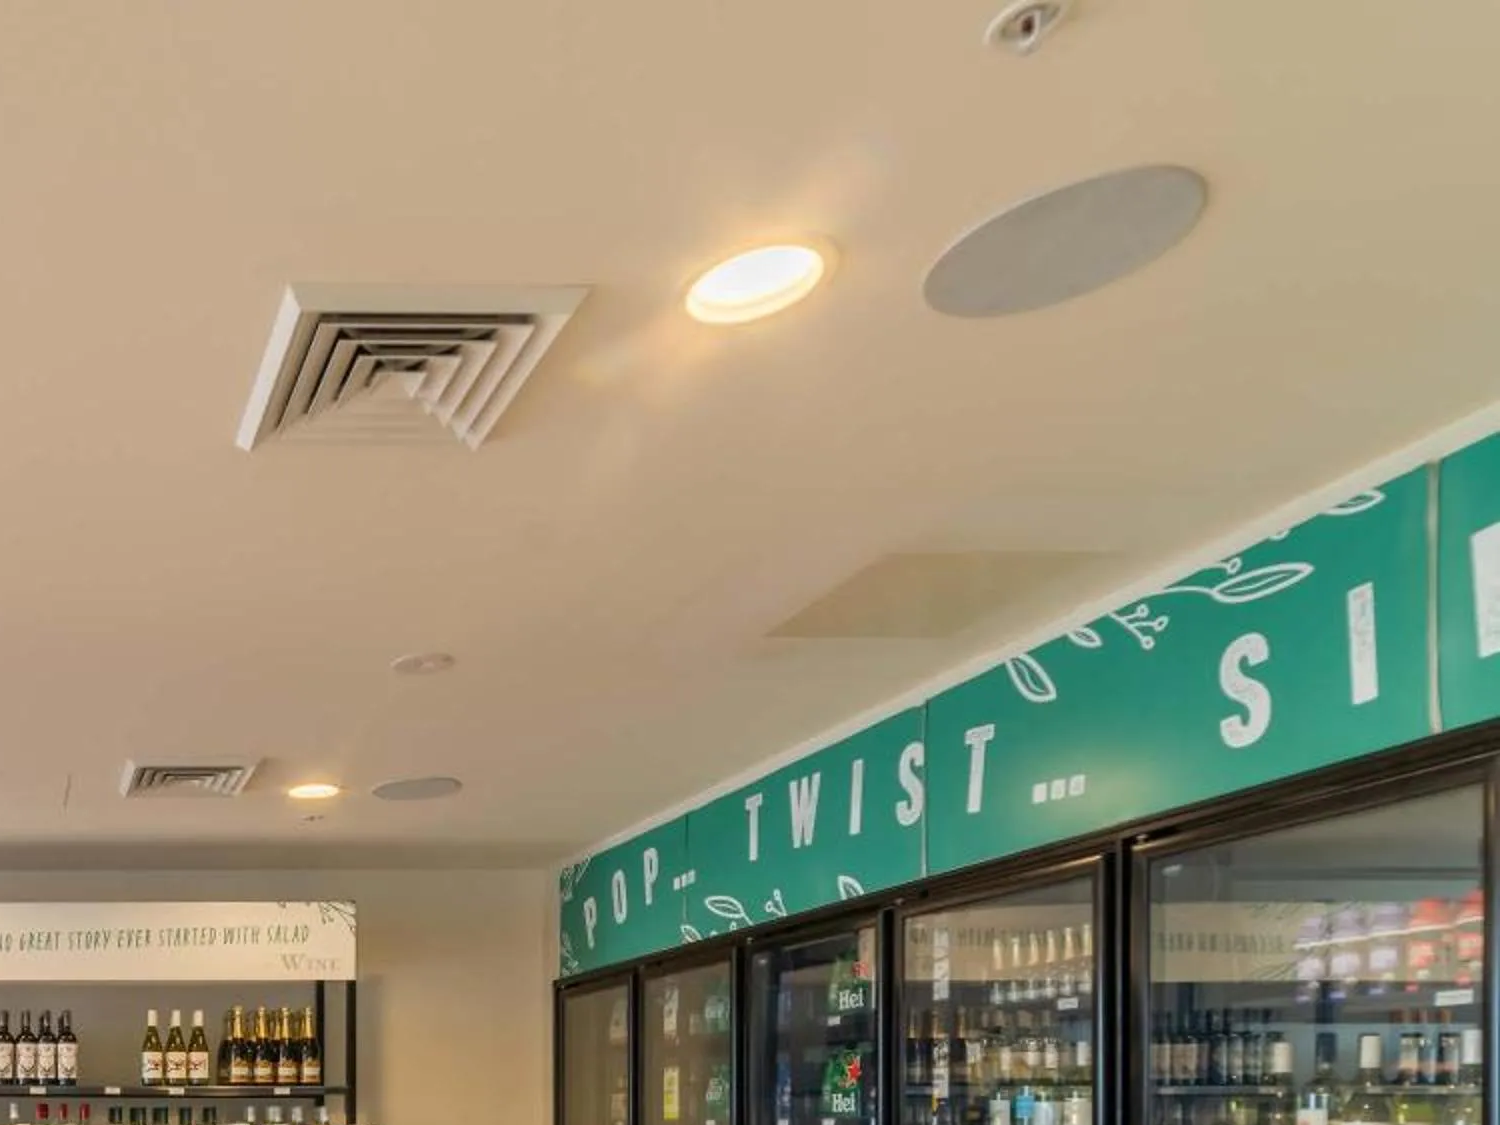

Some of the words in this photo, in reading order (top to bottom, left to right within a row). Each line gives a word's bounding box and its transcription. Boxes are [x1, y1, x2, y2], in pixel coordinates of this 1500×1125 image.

[18, 931, 61, 952] GREAT
[67, 930, 111, 951] STORY
[117, 929, 152, 949] EVER
[158, 927, 217, 948] STARTED
[222, 926, 260, 946] WITH
[267, 924, 310, 945] SALAD
